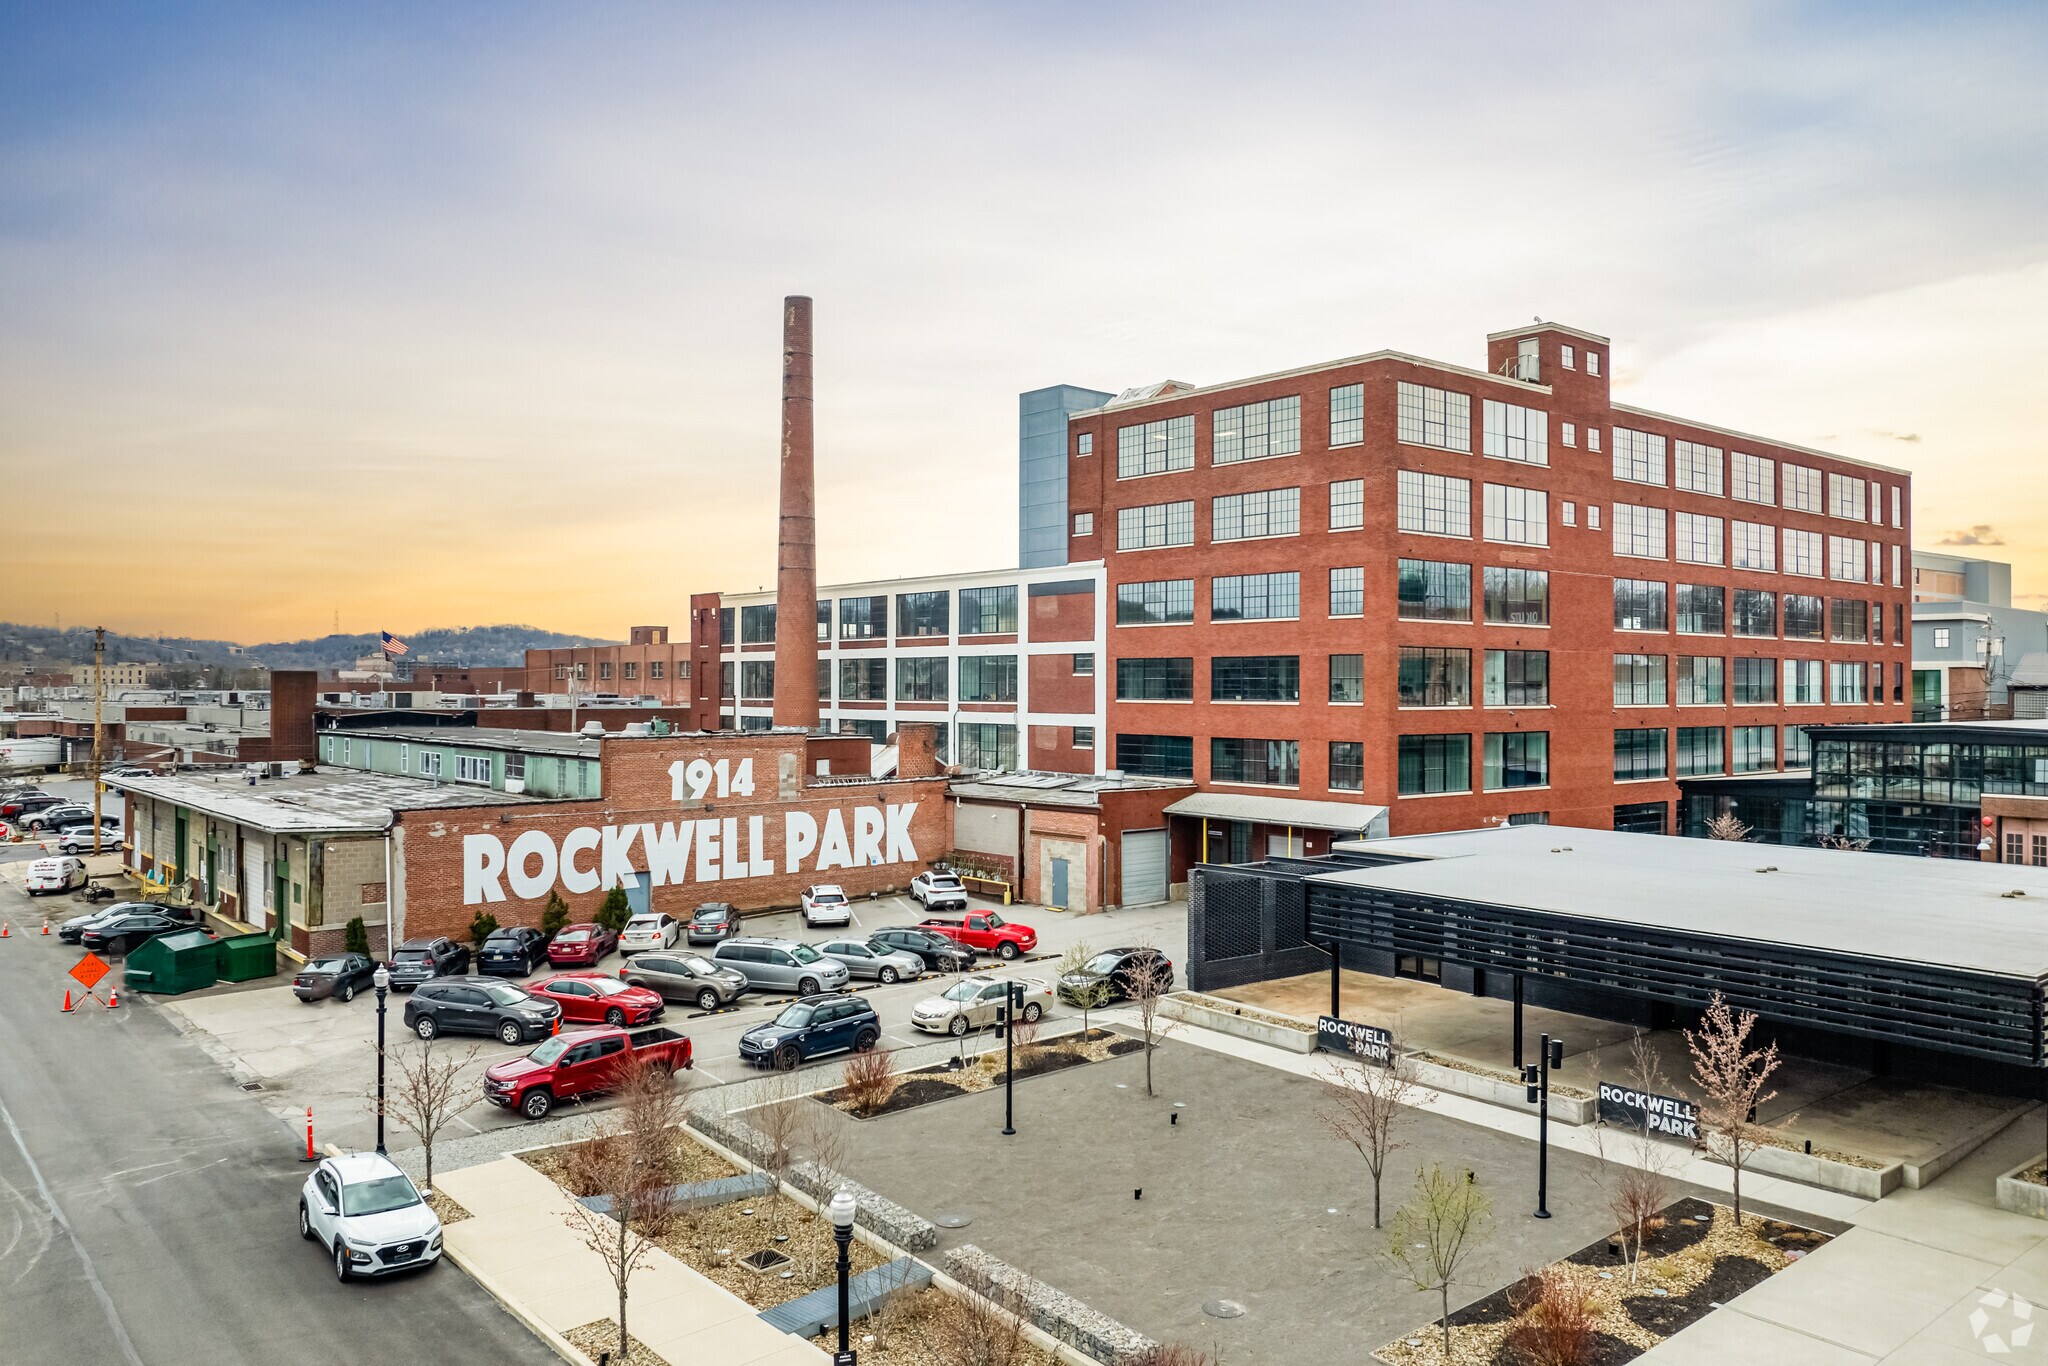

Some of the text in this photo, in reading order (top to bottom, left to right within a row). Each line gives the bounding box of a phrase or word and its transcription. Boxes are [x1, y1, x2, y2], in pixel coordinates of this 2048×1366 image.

[1510, 611, 1538, 623] STUDIO
[667, 758, 755, 801] 1914
[463, 803, 919, 905] ROCKWELL PARK
[1319, 1018, 1389, 1046] ROCKWELL
[1355, 1041, 1389, 1061] PARK
[1600, 1085, 1697, 1121] ROCKWELL
[1649, 1113, 1697, 1139] PARK
